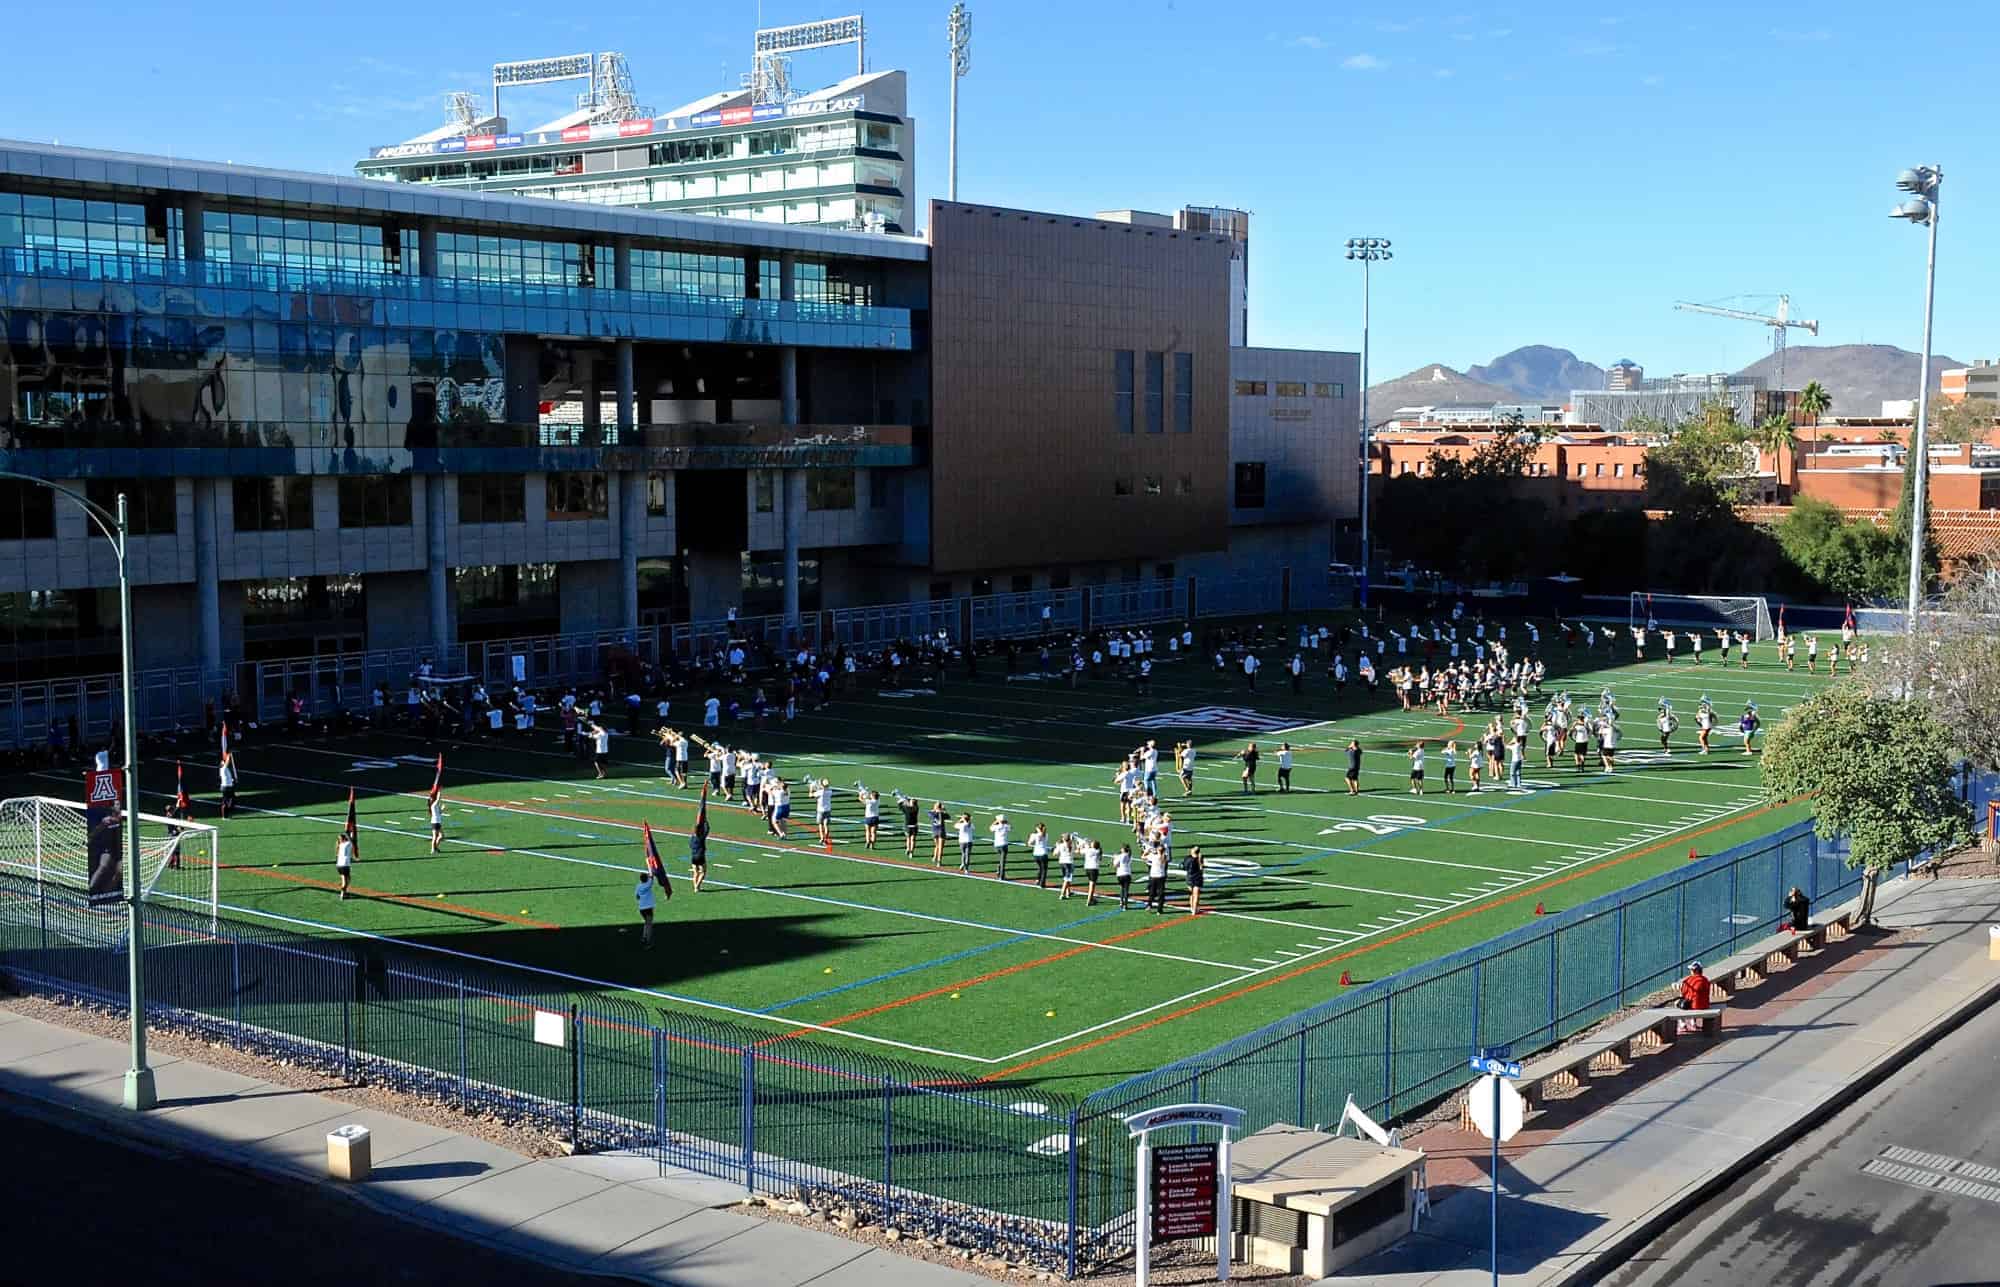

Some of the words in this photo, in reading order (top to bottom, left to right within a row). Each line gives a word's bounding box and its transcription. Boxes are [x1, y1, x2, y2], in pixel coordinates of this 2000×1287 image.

[789, 98, 860, 115] WILDCATS
[376, 142, 433, 158] ARIZONA
[91, 774, 118, 802] A
